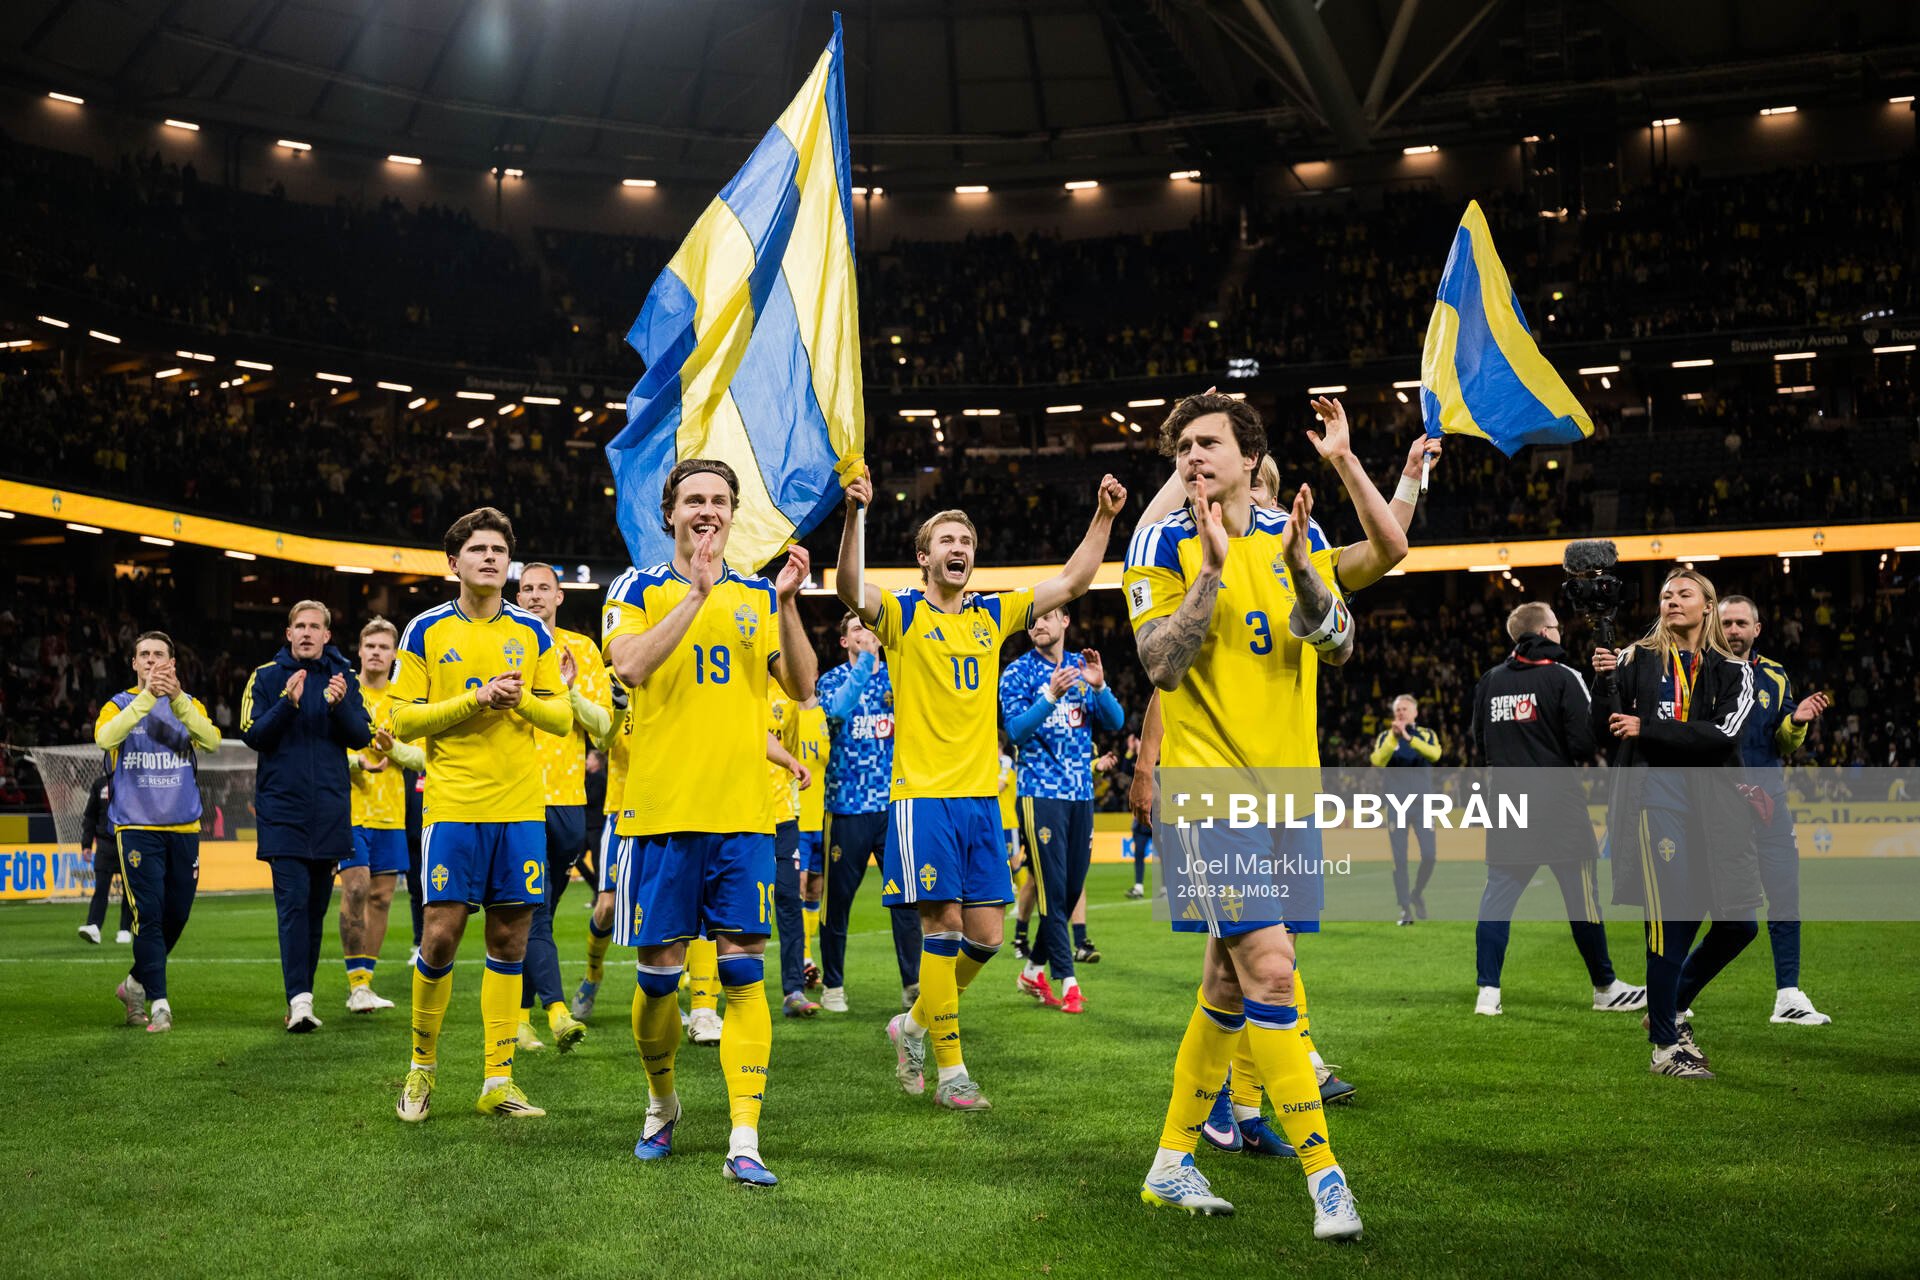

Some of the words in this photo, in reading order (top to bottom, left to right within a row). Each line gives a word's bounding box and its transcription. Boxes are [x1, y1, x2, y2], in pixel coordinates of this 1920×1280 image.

[1731, 337, 1805, 352] Strawberry
[1808, 334, 1849, 347] Arena
[577, 564, 591, 583] 3
[1245, 610, 1273, 655] 3
[693, 644, 730, 685] 19
[950, 656, 979, 691] 10
[1491, 708, 1516, 722] SPEL
[801, 741, 819, 760] 14
[123, 752, 192, 769] #FOOTBALL
[149, 776, 181, 785] RESPECT
[0, 850, 47, 892] FÖR
[1282, 1100, 1322, 1114] SVERIGE
